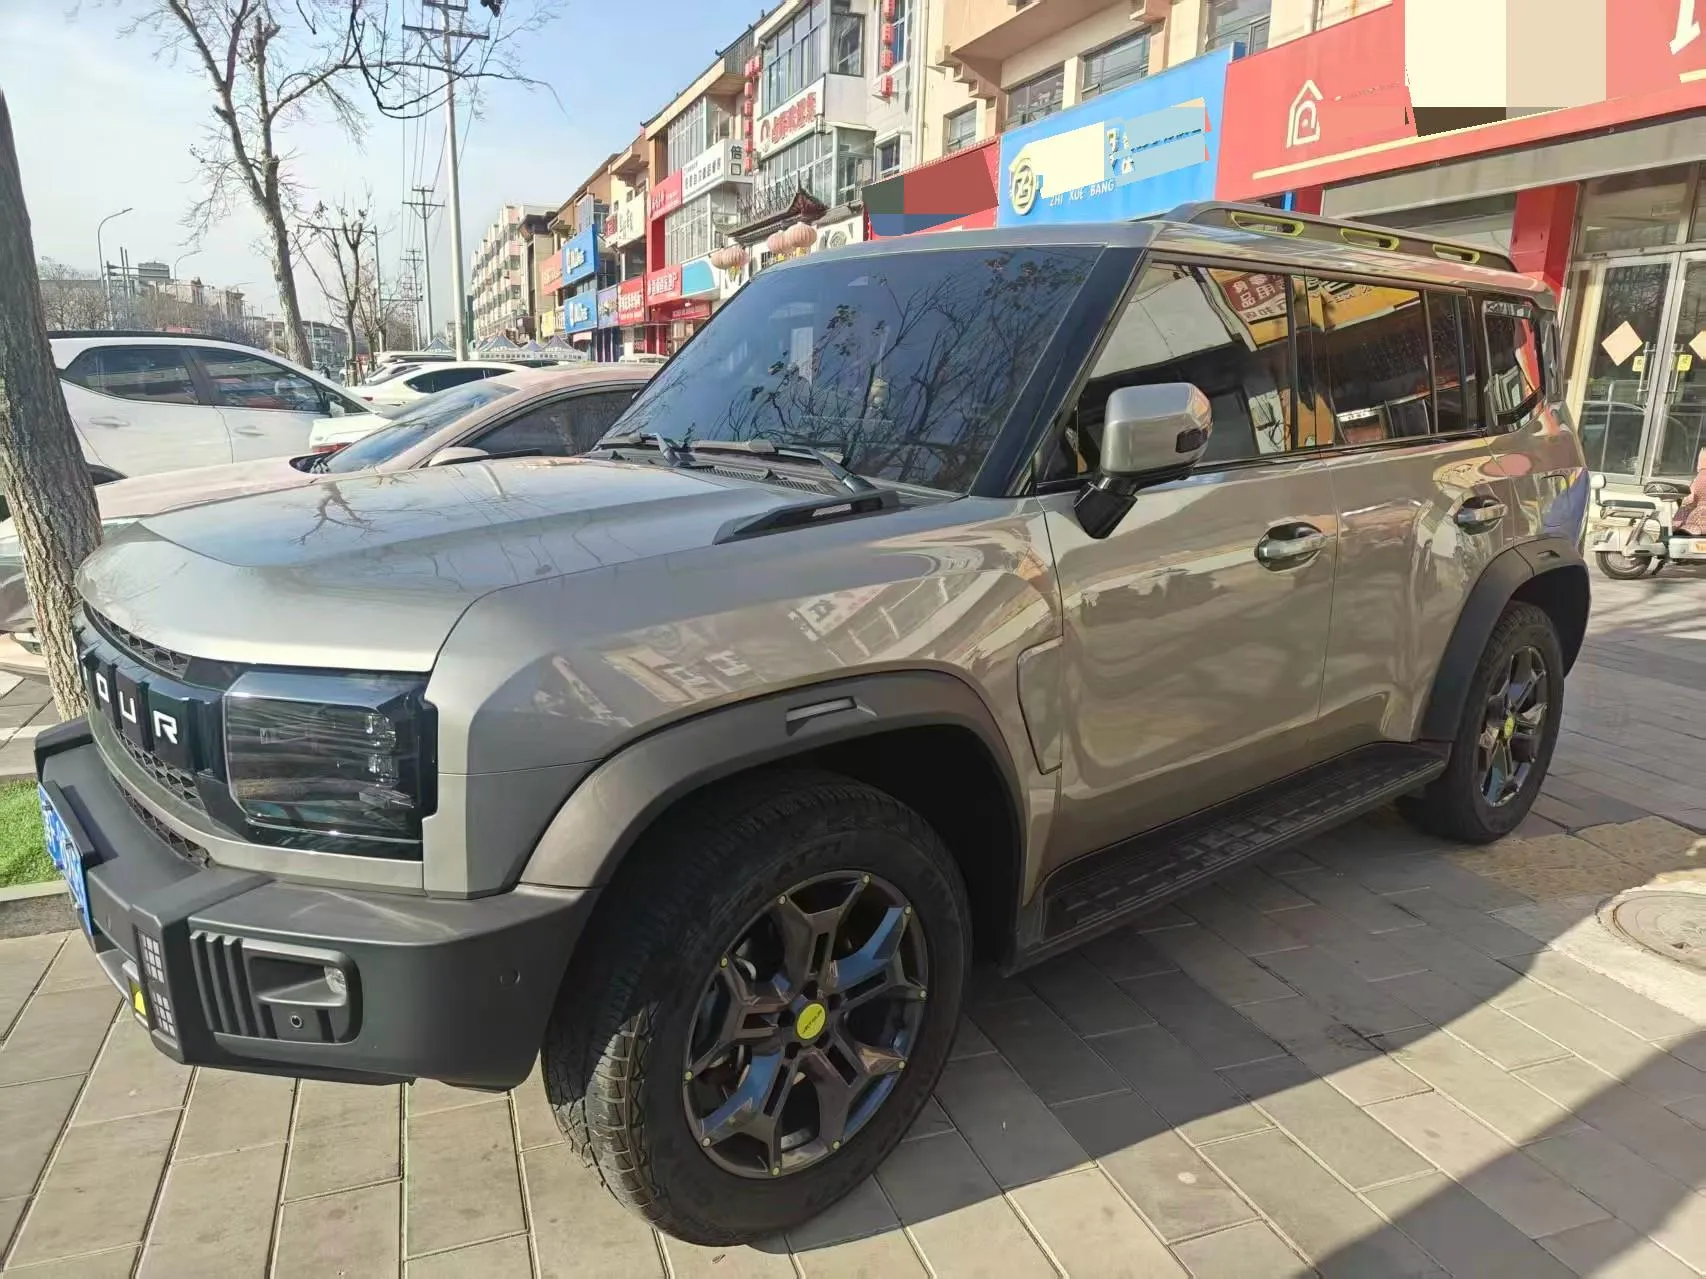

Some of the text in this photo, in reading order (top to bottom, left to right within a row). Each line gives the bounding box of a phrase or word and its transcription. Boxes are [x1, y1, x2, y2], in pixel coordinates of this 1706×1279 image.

[1069, 188, 1084, 201] XUE
[1090, 179, 1115, 197] BANG
[83, 666, 178, 745] OUR
